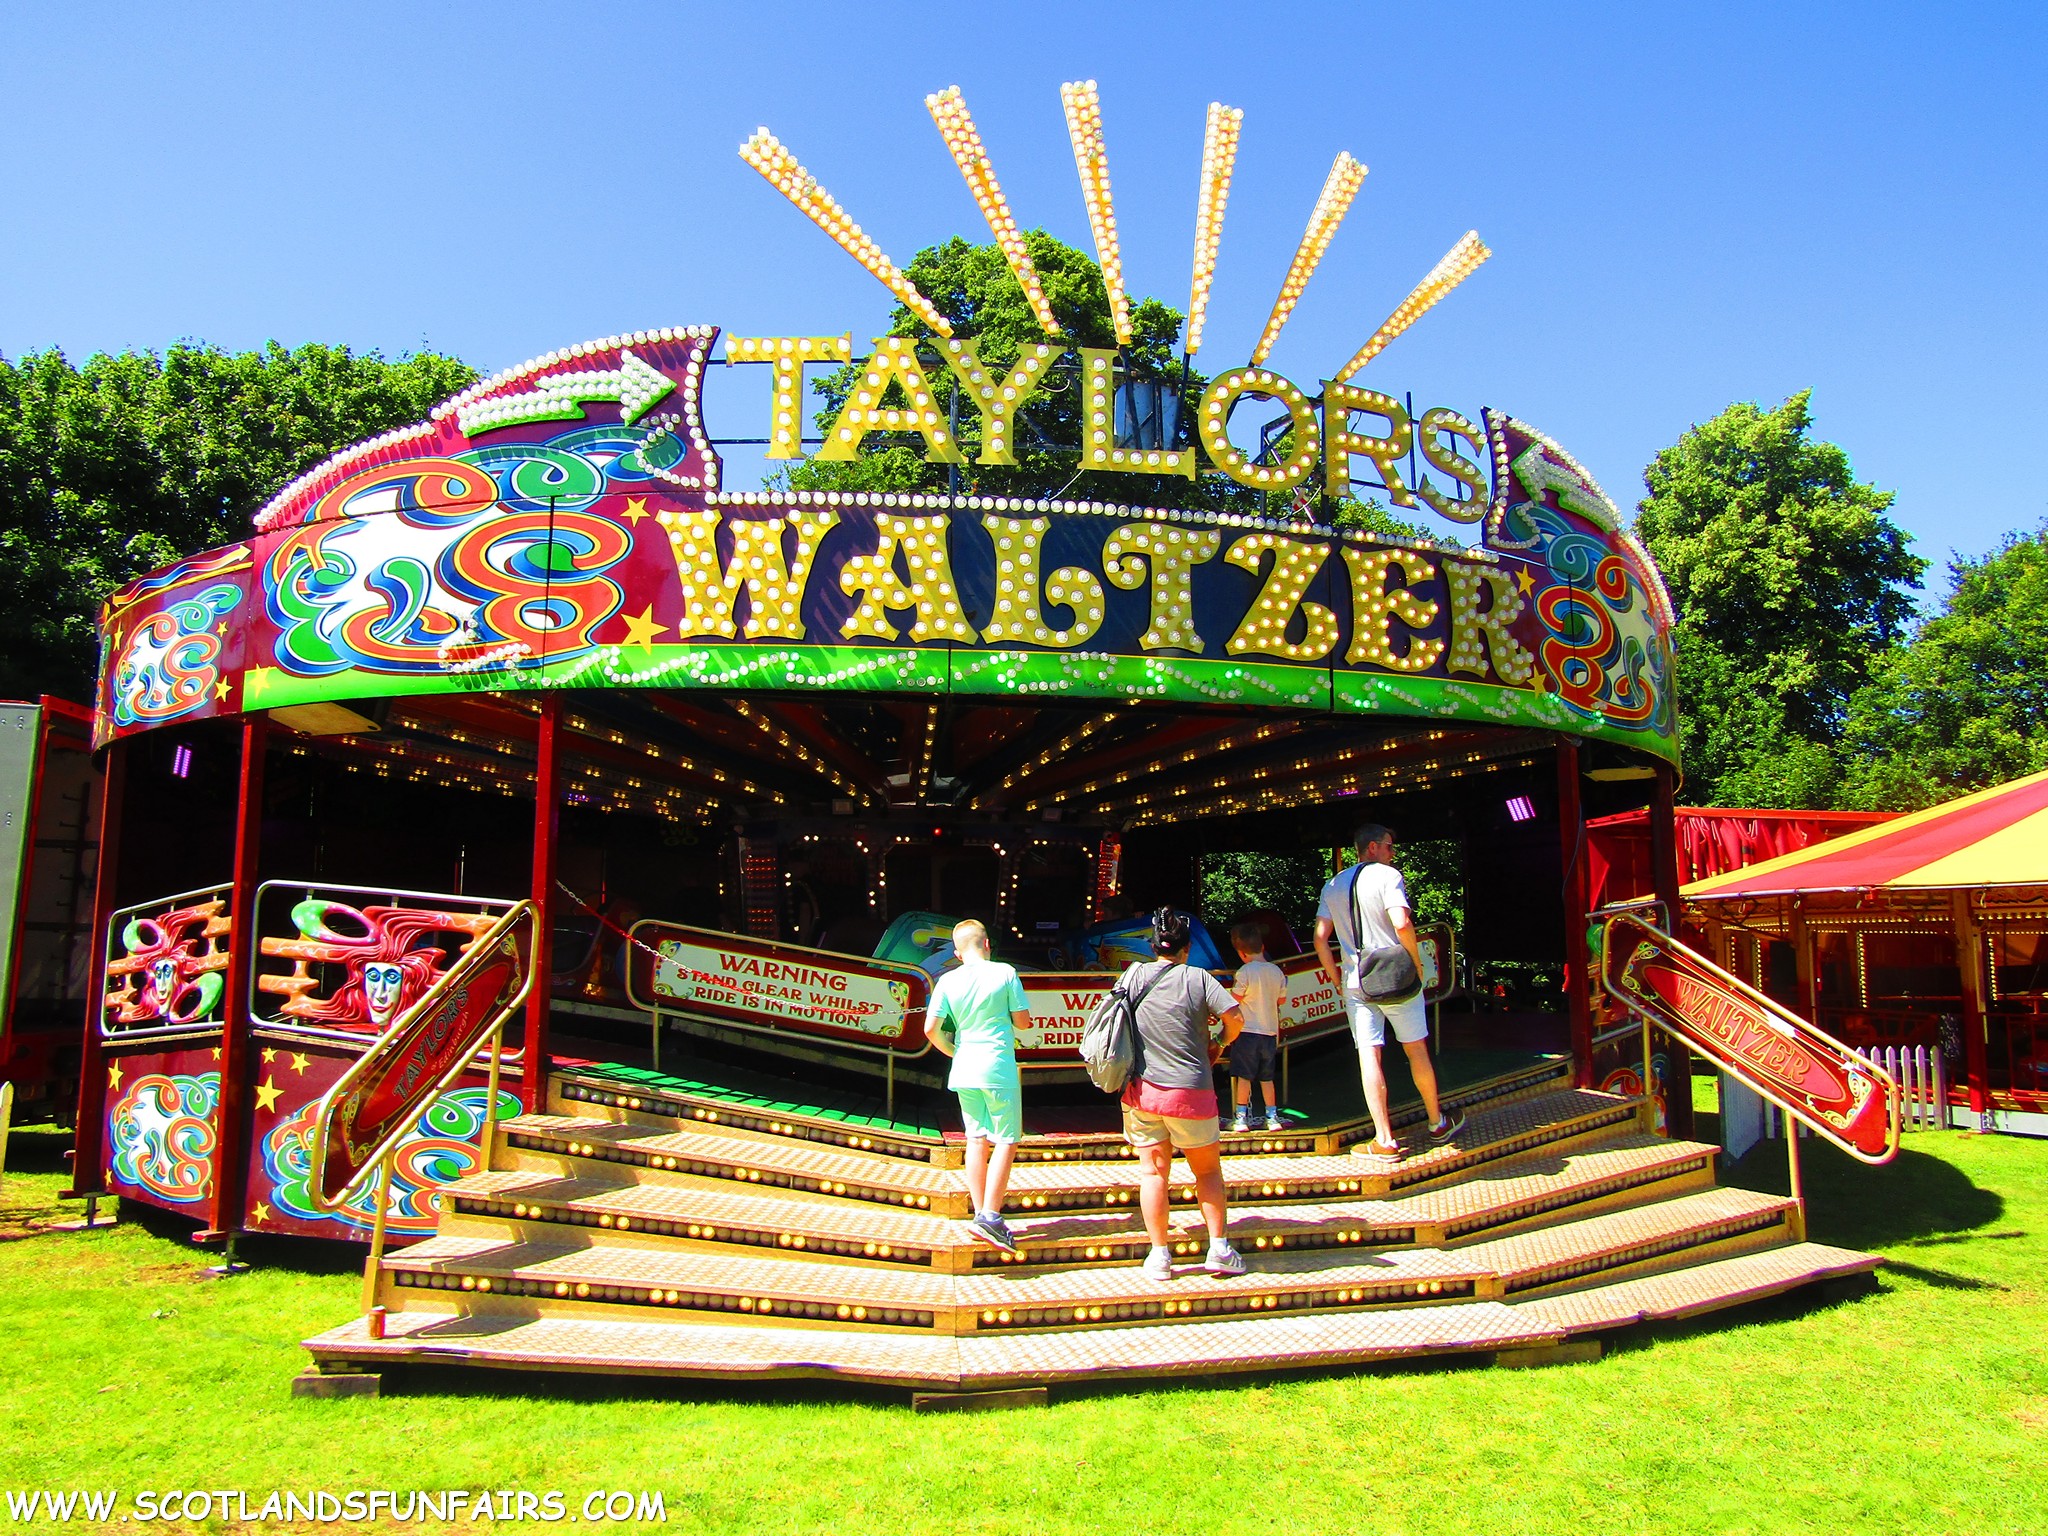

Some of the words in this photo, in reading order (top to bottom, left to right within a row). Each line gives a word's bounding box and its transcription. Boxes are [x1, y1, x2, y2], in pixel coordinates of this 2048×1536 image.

[725, 330, 1493, 524] TAYLORS
[656, 508, 1535, 687] WALTZER
[677, 968, 738, 989] STAND
[742, 980, 803, 1001] CLEAR
[809, 992, 884, 1015] WHILST
[719, 953, 848, 992] WARNING
[1291, 988, 1333, 1009] STAND
[695, 986, 737, 1005] RIDE
[742, 994, 760, 1009] IS
[764, 997, 784, 1014] IN
[789, 1005, 861, 1028] MOTION
[1307, 1001, 1337, 1018] RIDE
[1676, 978, 1811, 1085] WALTZER
[392, 982, 469, 1102] TAYLORS
[439, 1010, 470, 1069] Edinburgh
